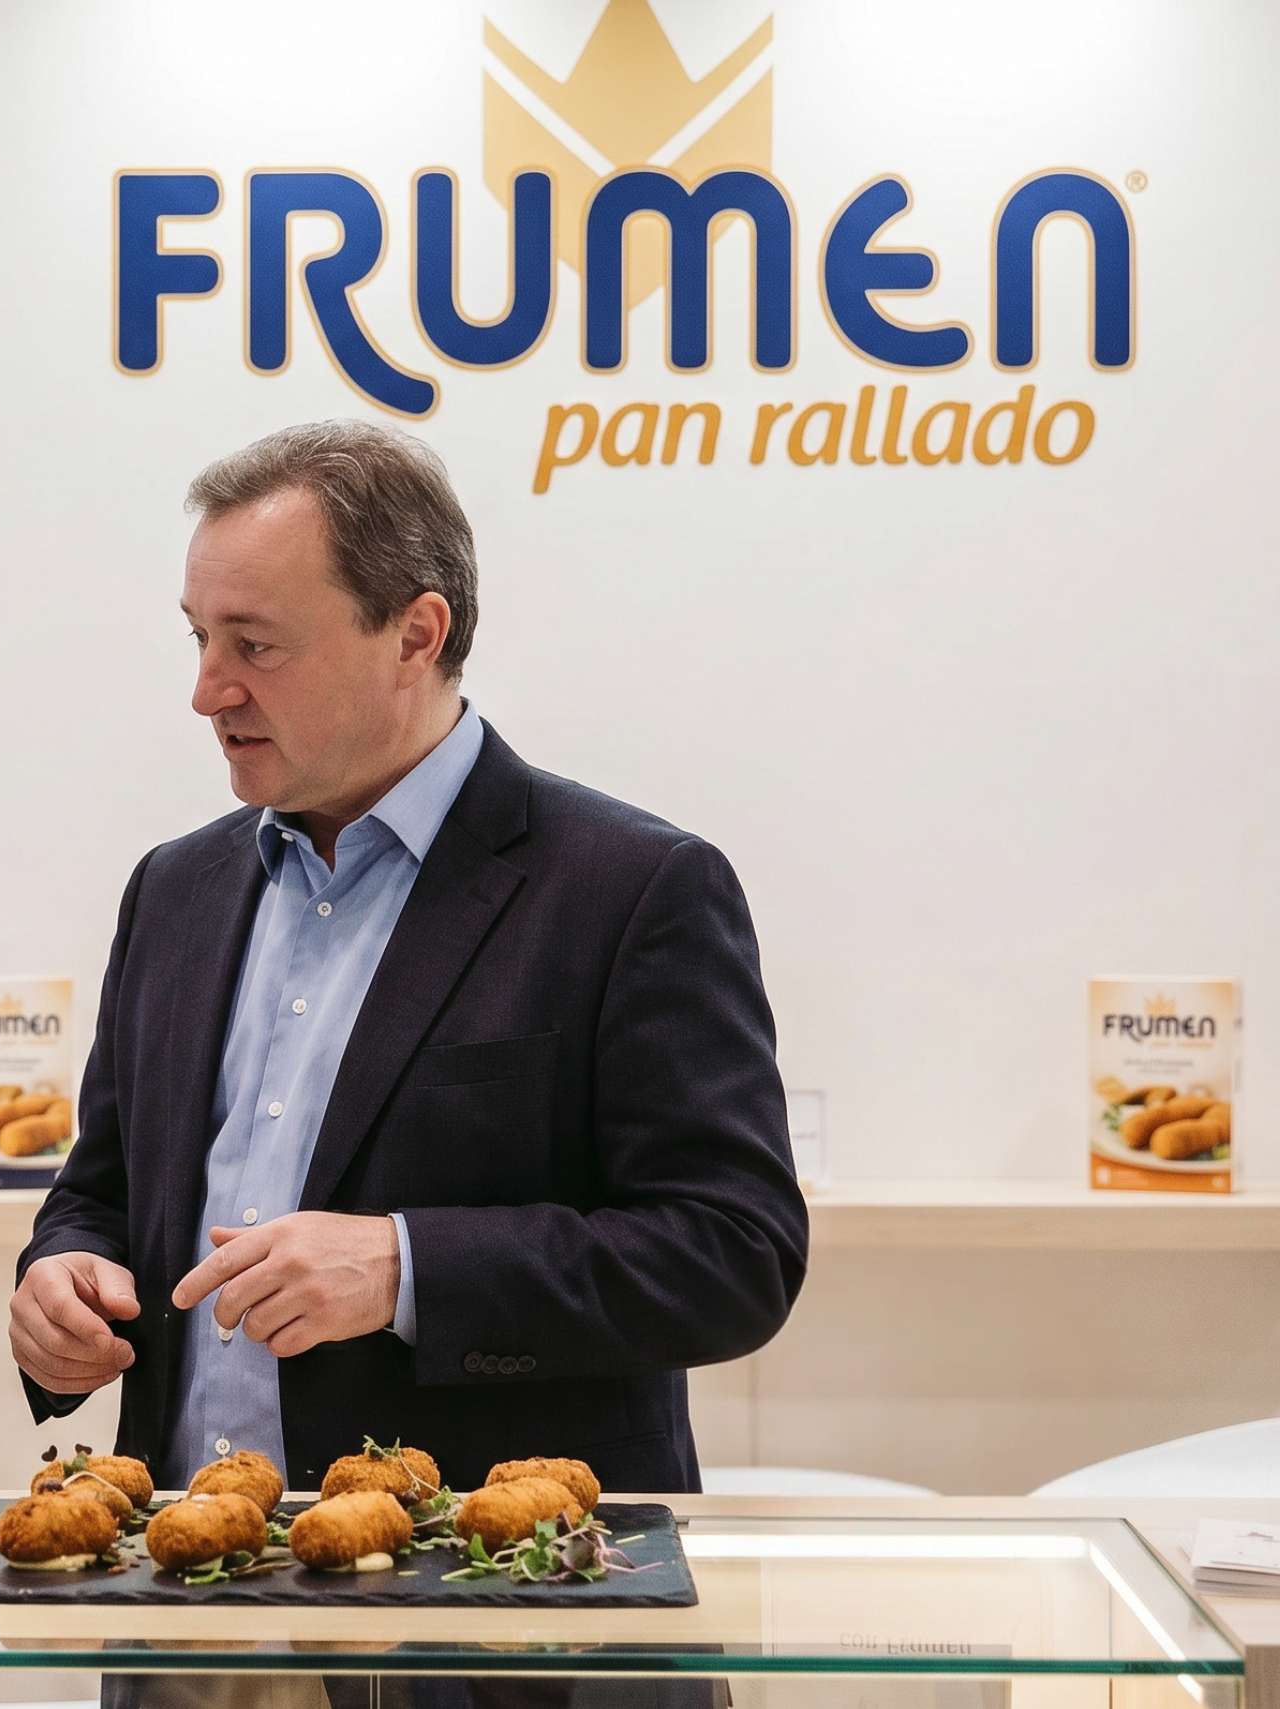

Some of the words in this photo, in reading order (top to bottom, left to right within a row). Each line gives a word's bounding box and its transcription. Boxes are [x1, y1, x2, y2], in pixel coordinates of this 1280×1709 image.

[114, 167, 1136, 420] FRUMEN
[532, 398, 721, 494] pan
[750, 385, 1096, 466] rallado
[1102, 1013, 1218, 1043] FRUMEN
